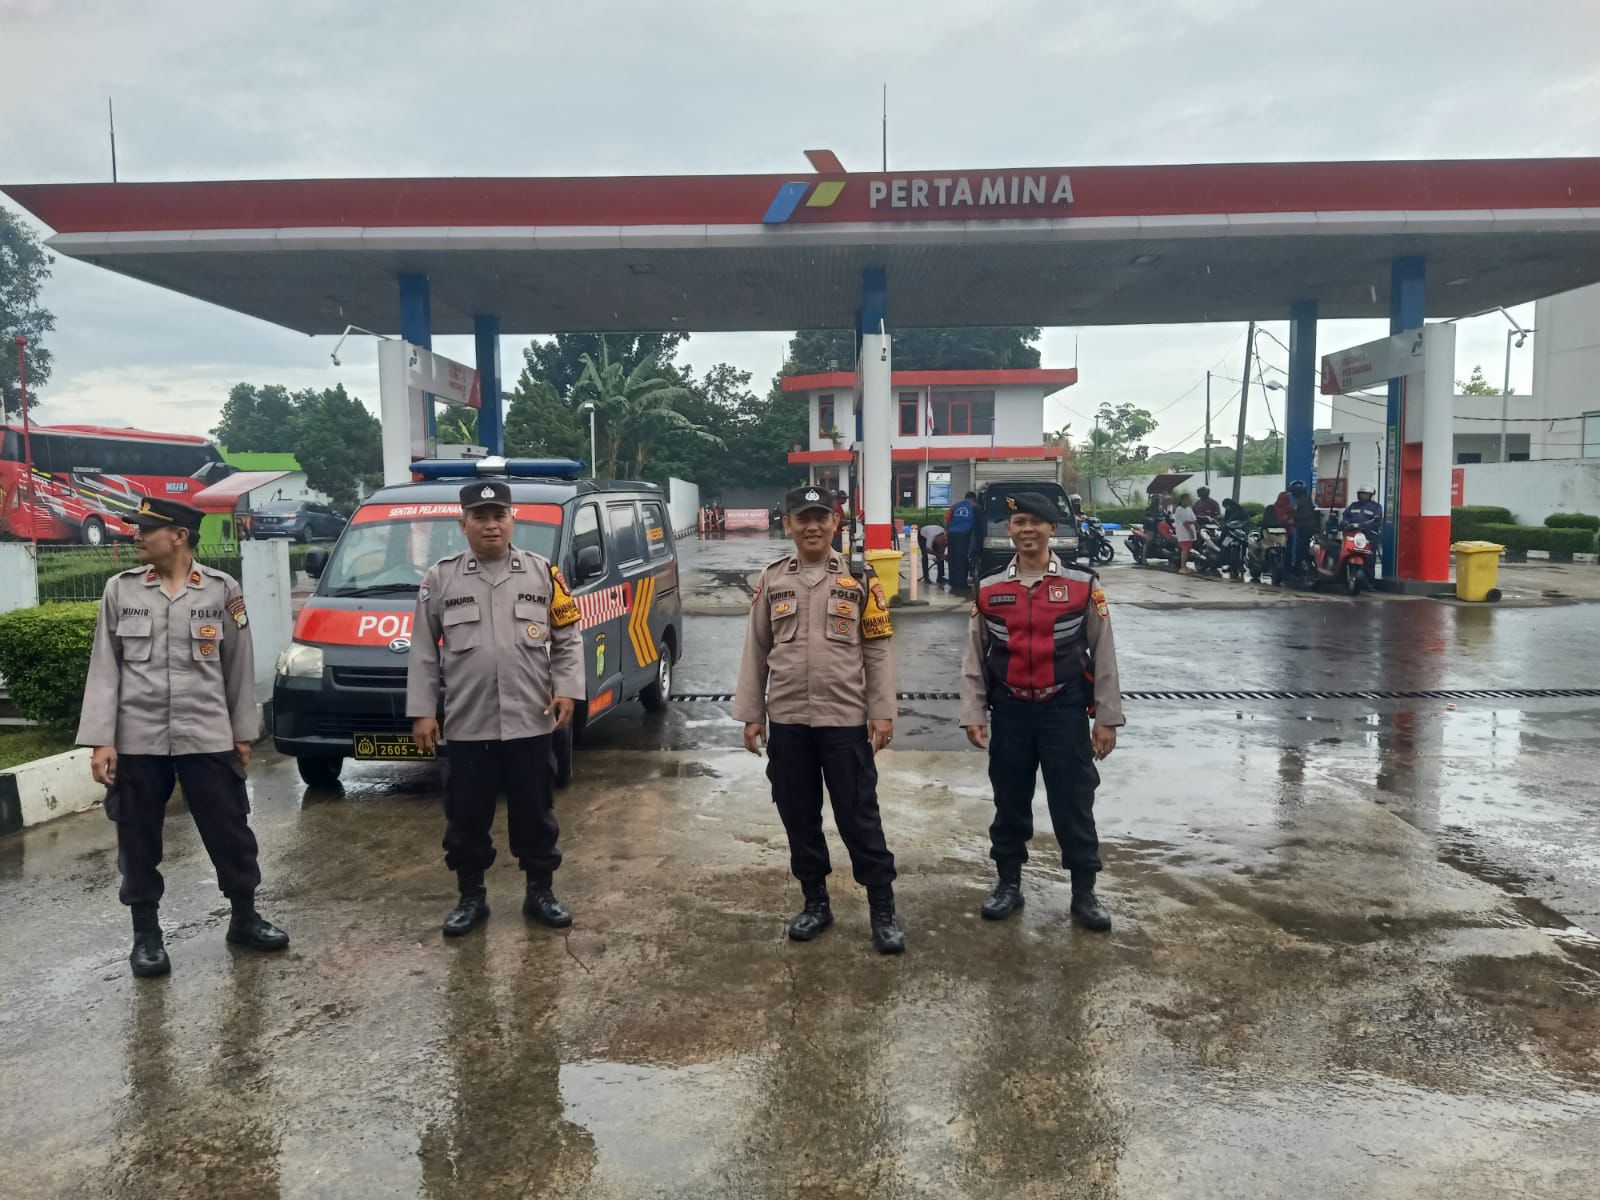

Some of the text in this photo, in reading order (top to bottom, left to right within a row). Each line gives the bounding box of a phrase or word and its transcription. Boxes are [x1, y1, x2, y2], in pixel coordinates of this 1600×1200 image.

[869, 175, 1075, 209] PERTAMINA
[388, 506, 417, 517] SENTRA
[518, 593, 546, 604] POLRI
[830, 589, 858, 600] POLRI
[122, 608, 149, 617] MUNIR
[358, 615, 412, 637] POL
